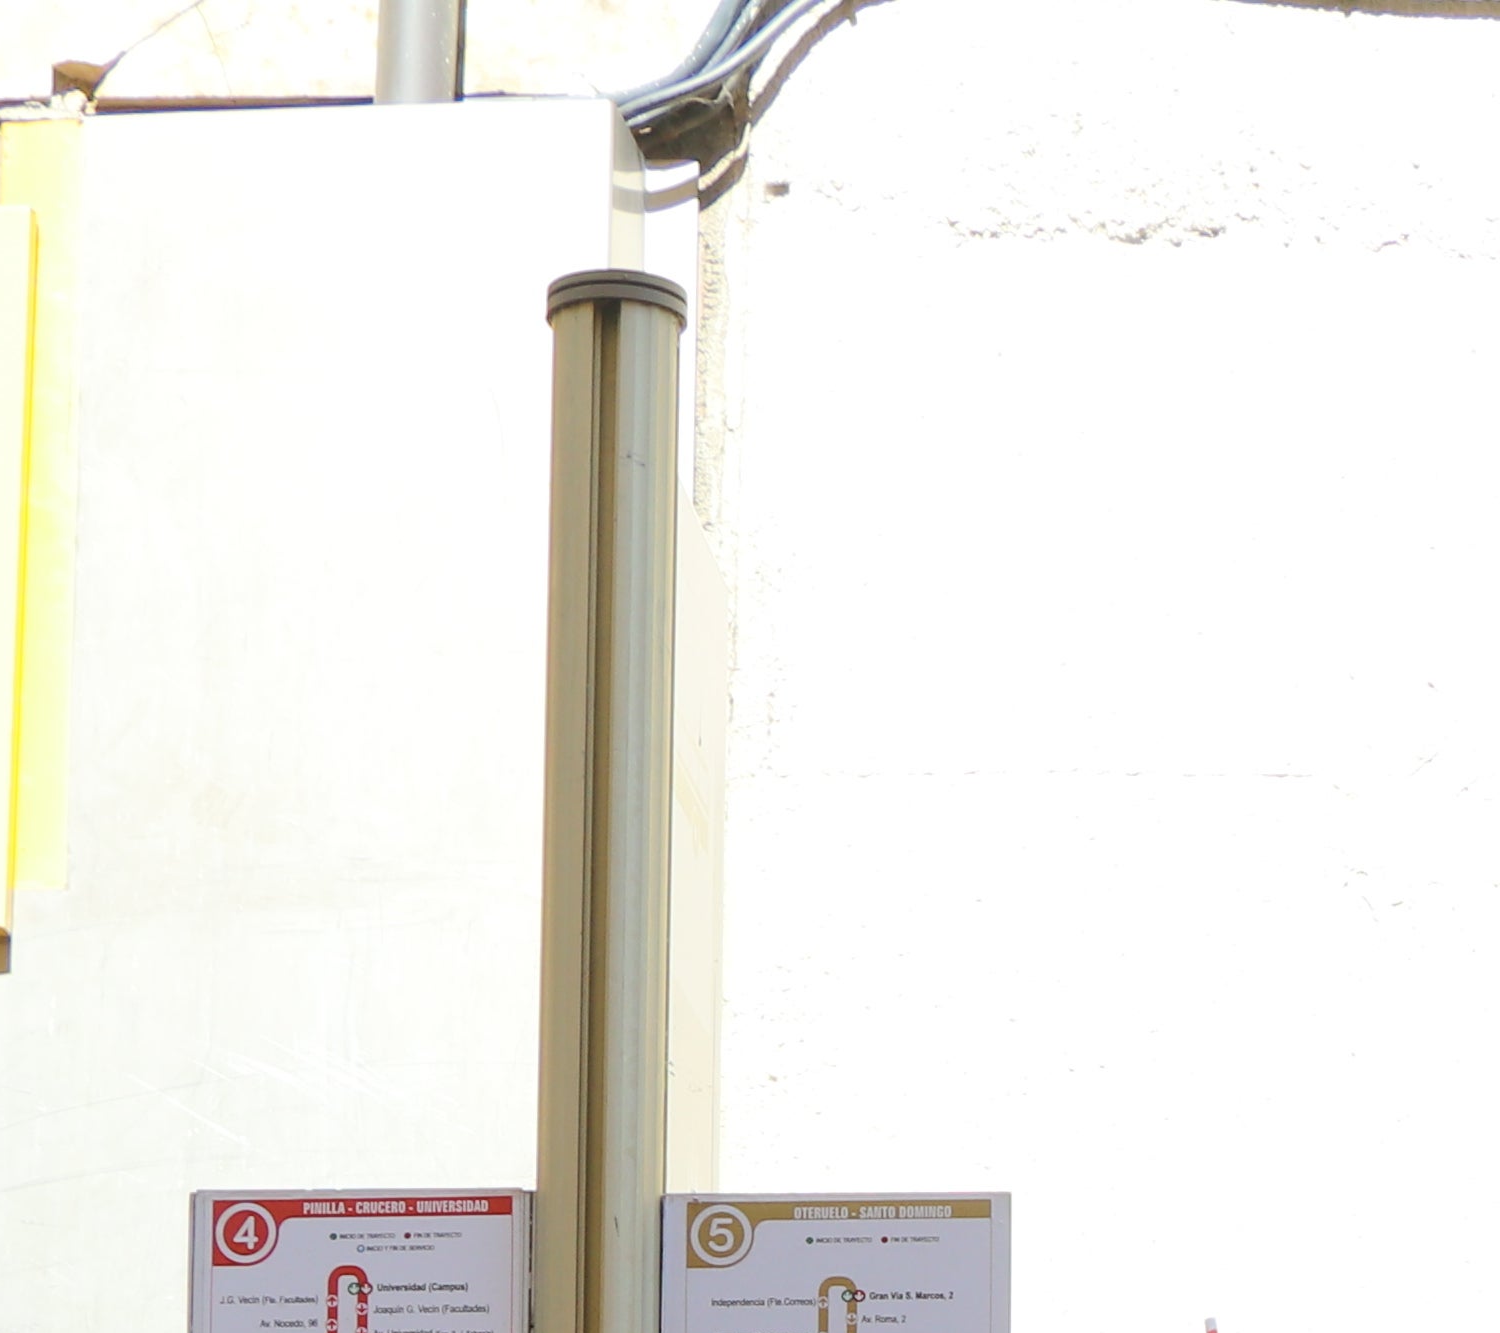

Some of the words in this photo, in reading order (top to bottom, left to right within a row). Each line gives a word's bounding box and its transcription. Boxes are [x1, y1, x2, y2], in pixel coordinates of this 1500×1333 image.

[303, 1202, 345, 1214] PINILLA
[355, 1201, 406, 1213] CRUCERO
[416, 1200, 489, 1213] UNIVERSIDAD
[794, 1206, 849, 1219] OTERUELO
[859, 1205, 897, 1218] SANTO
[899, 1205, 952, 1218] DOMINGO
[232, 1215, 259, 1250] 4
[707, 1217, 734, 1252] 5
